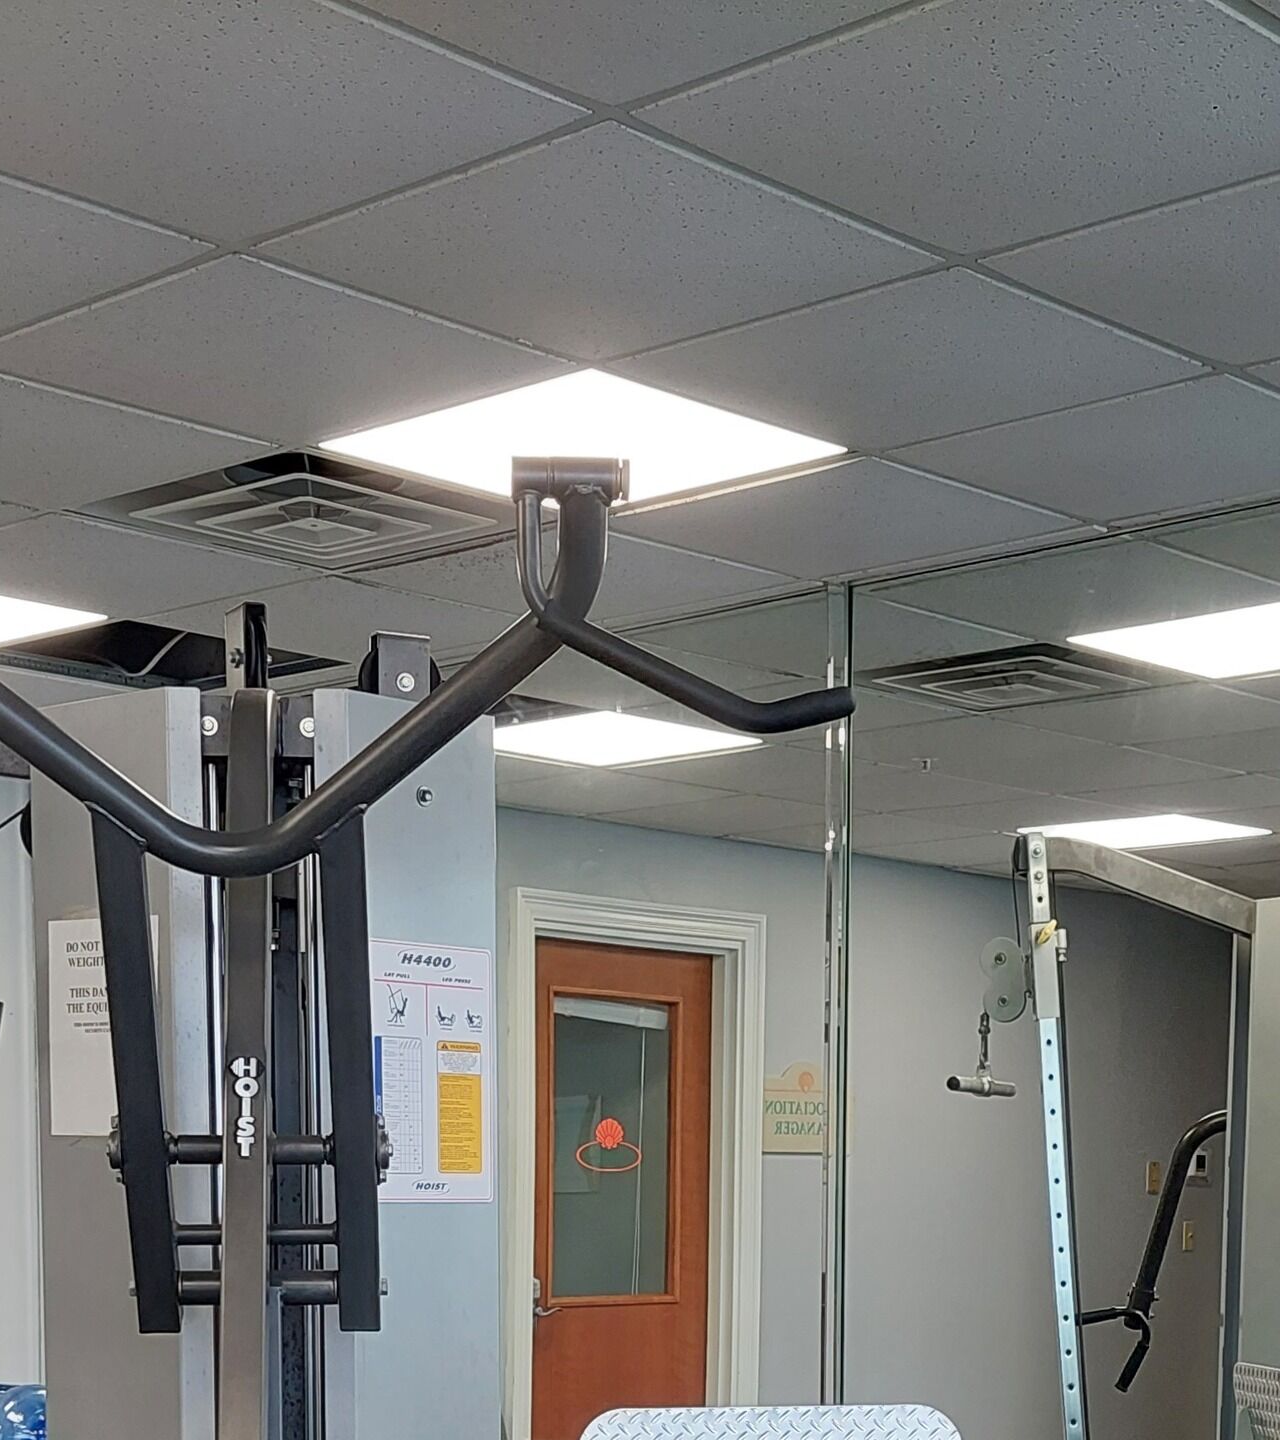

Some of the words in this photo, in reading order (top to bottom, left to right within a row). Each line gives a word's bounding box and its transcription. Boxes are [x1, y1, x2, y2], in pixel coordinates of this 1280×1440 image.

[66, 942, 79, 952] DO
[81, 941, 100, 952] NOT
[401, 953, 452, 968] H4400
[70, 988, 90, 998] THIS
[93, 987, 106, 997] DA
[66, 1003, 84, 1014] THE
[87, 1002, 108, 1016] EQUI
[232, 1057, 261, 1157] HOIST
[415, 1182, 448, 1190] HOIST
